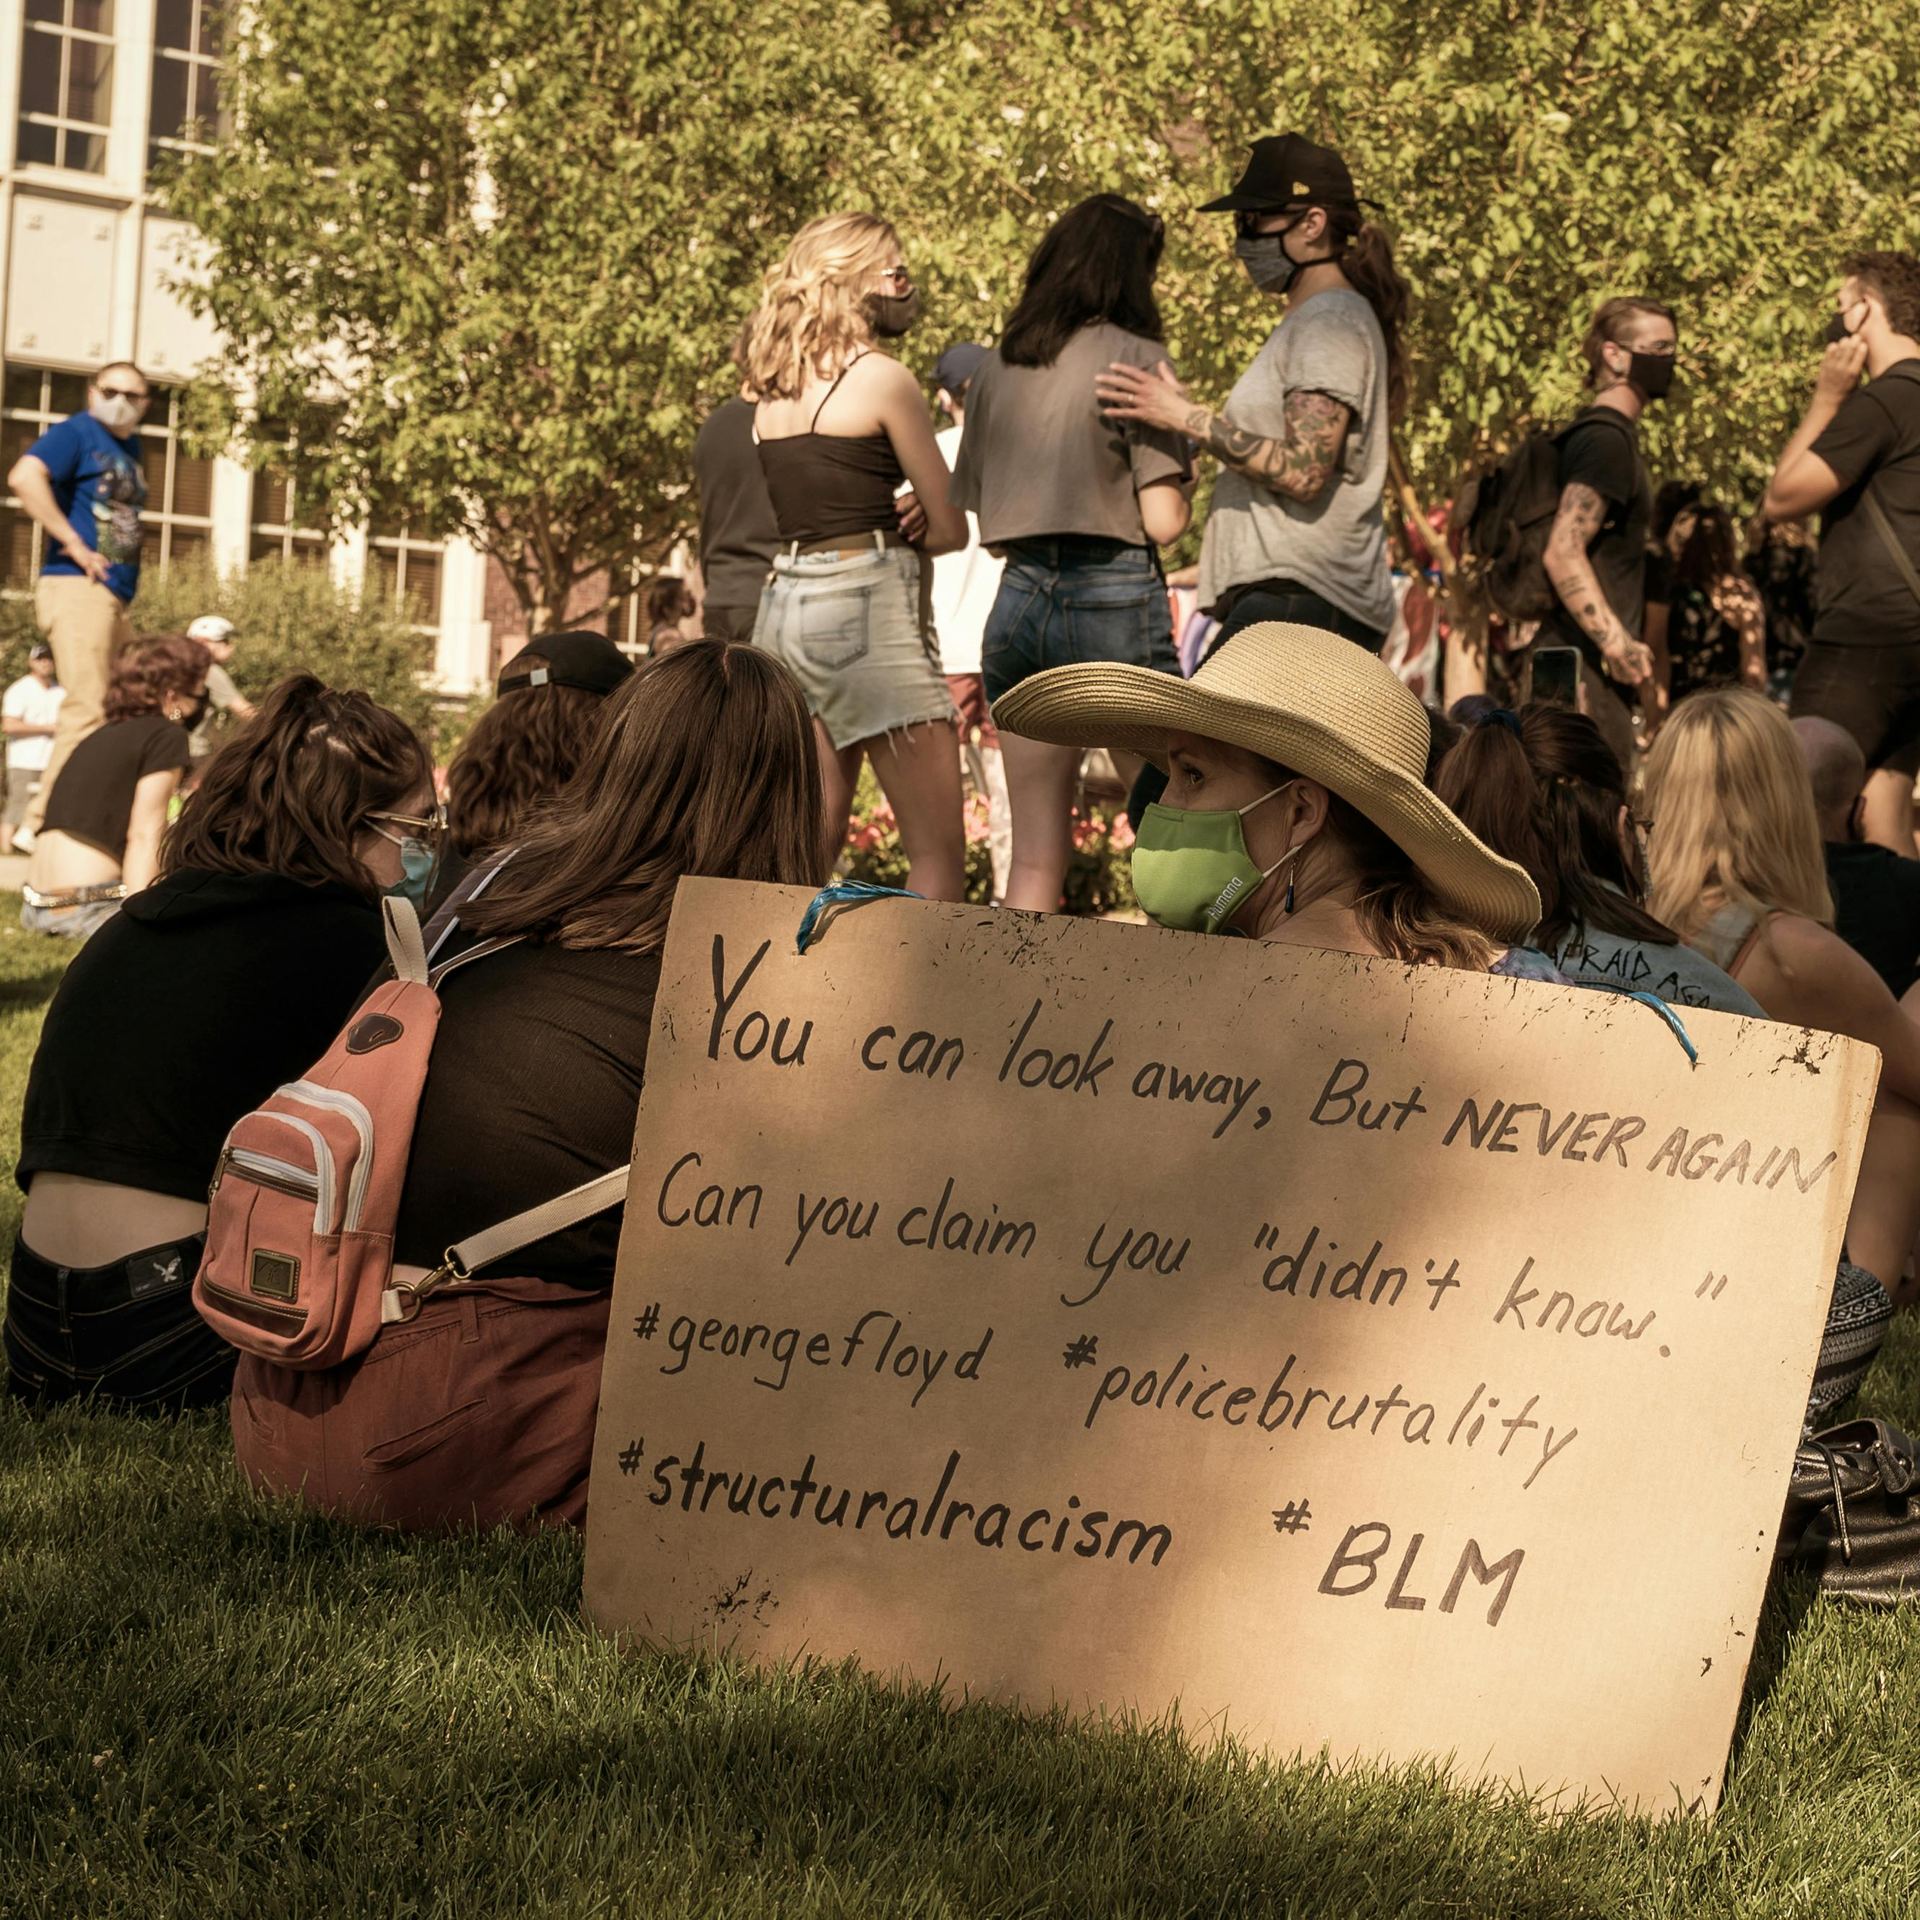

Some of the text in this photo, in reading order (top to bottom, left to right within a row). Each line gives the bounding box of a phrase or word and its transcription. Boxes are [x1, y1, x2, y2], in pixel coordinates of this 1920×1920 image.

[1206, 876, 1244, 922] Humana
[708, 934, 1838, 1194] You can look away, But NEVER AGAIN
[657, 1151, 763, 1230] Can
[784, 1193, 880, 1266] you
[897, 1177, 1037, 1259] claim
[1061, 1222, 1191, 1307] you
[1252, 1222, 1461, 1311] "didn't
[633, 1302, 1578, 1490] #georgefloyd #policebrutality
[618, 1437, 1526, 1627] #structuralracism #BLM
